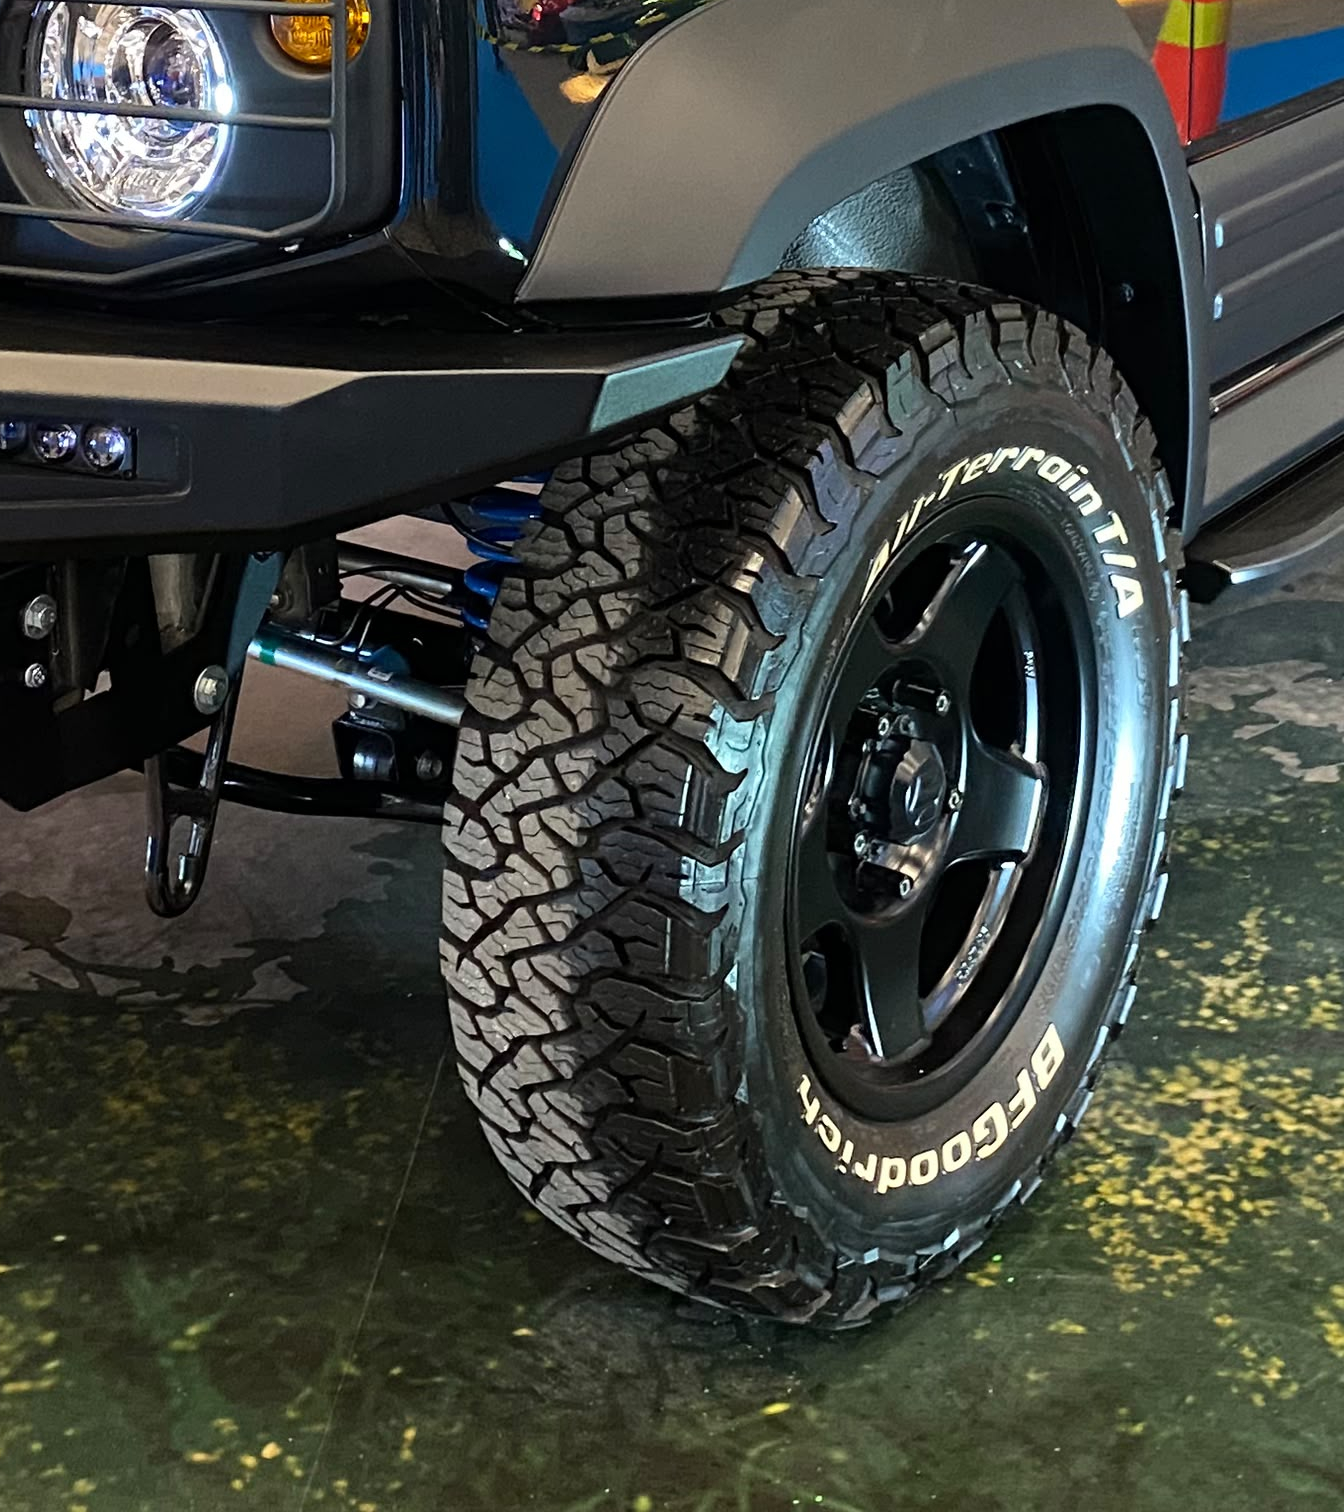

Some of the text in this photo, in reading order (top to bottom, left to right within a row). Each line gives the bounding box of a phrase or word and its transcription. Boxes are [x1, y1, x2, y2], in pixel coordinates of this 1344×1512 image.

[860, 446, 1103, 606] All-Terrain
[1093, 511, 1145, 621] T/A
[795, 1022, 1066, 1195] BFGoodrich
